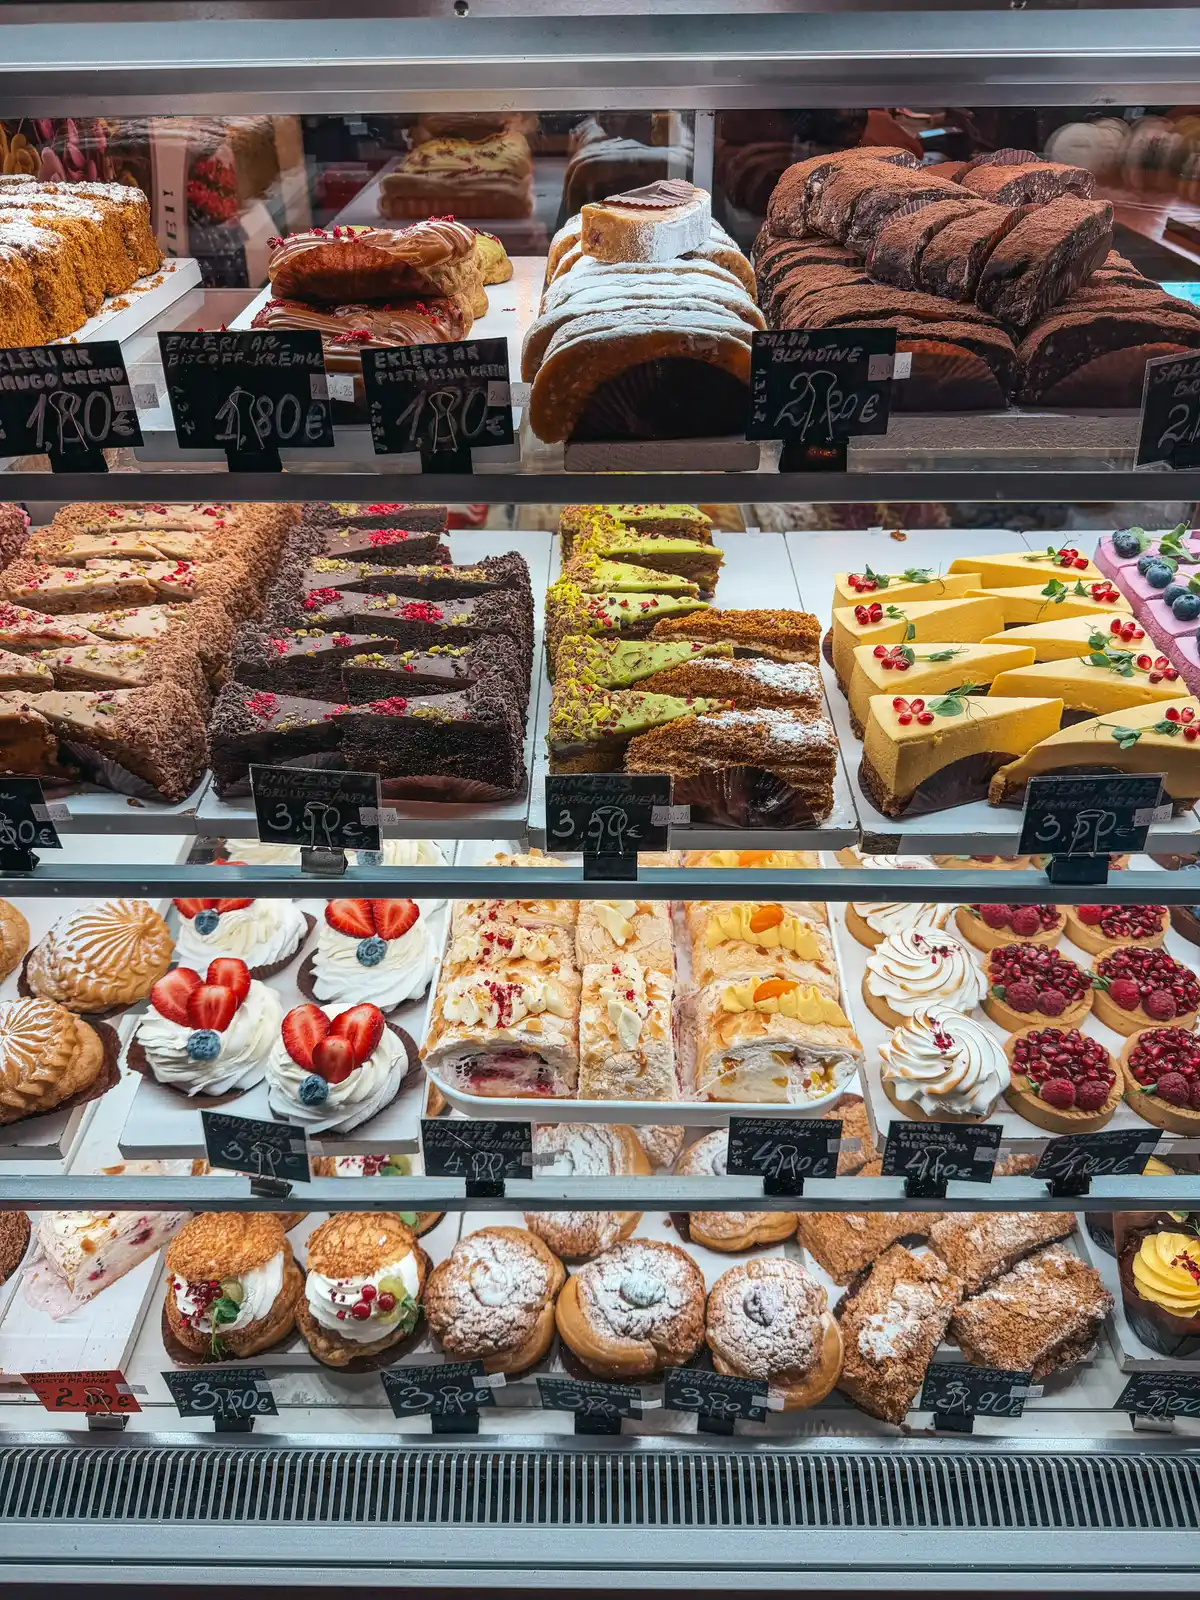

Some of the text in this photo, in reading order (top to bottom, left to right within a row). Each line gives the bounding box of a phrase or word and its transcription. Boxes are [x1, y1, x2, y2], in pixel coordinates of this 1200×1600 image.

[0, 373, 58, 391] ANGO
[552, 809, 645, 839] 3,50€
[190, 1382, 272, 1412] 3,50€
